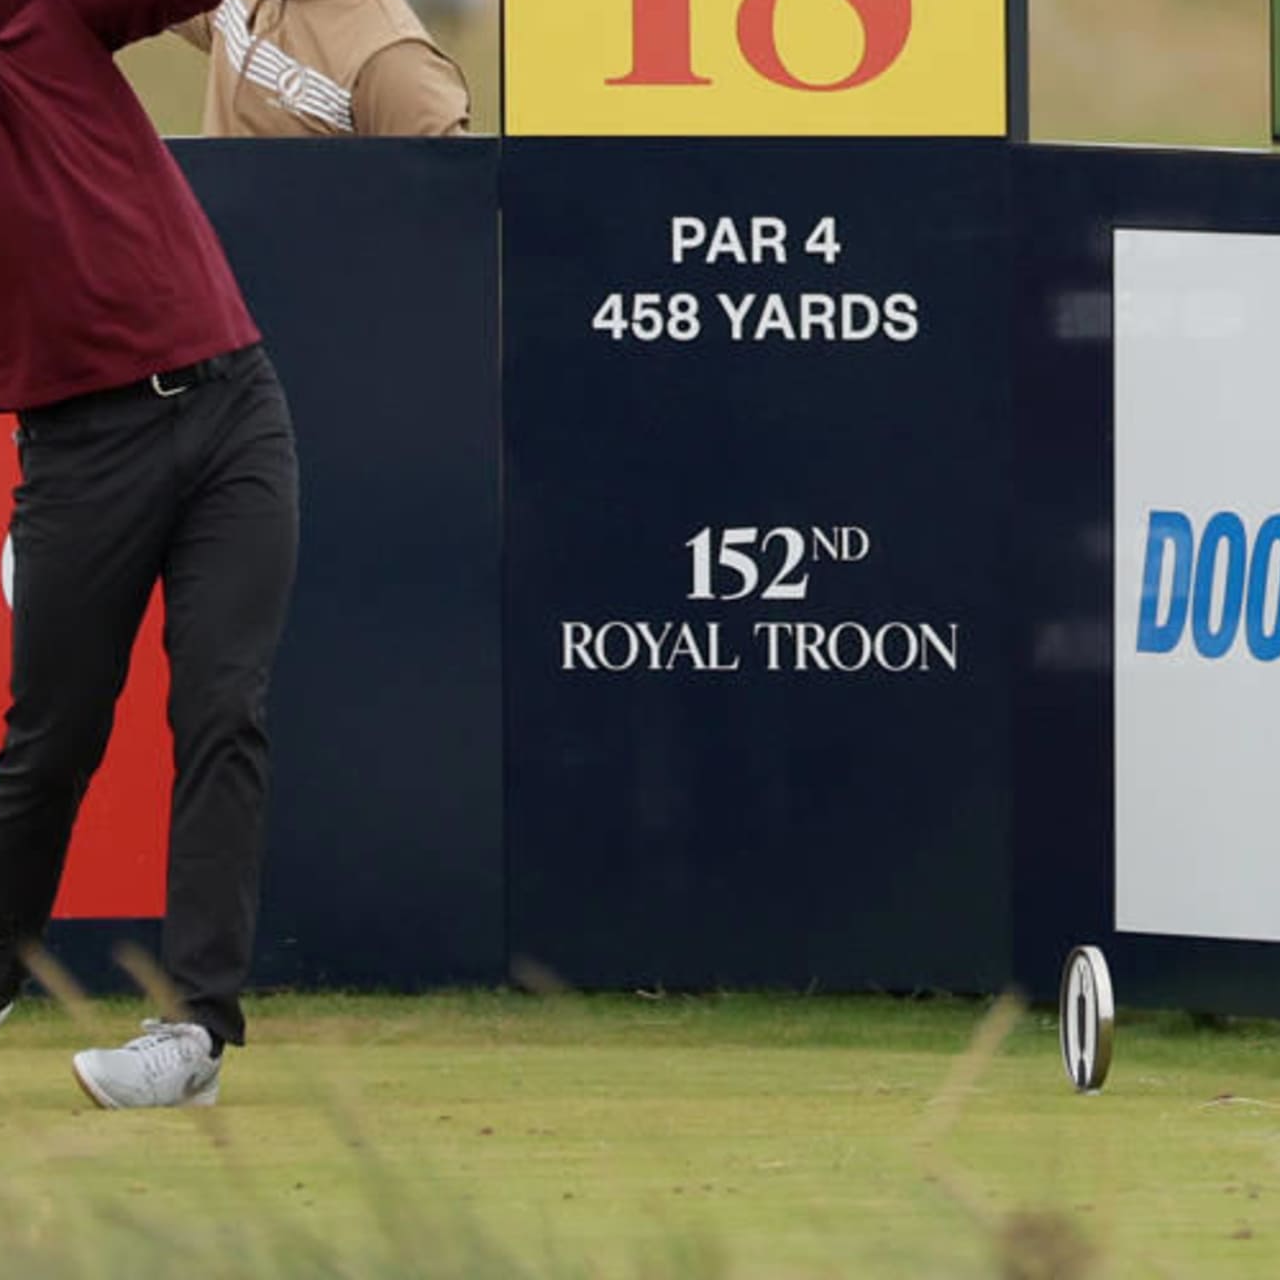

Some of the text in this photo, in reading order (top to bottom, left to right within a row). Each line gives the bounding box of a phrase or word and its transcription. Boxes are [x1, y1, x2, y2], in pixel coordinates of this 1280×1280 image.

[672, 217, 841, 264] PAR 4
[592, 293, 918, 341] 458 YARDS
[562, 621, 958, 672] ROYAL TROON
